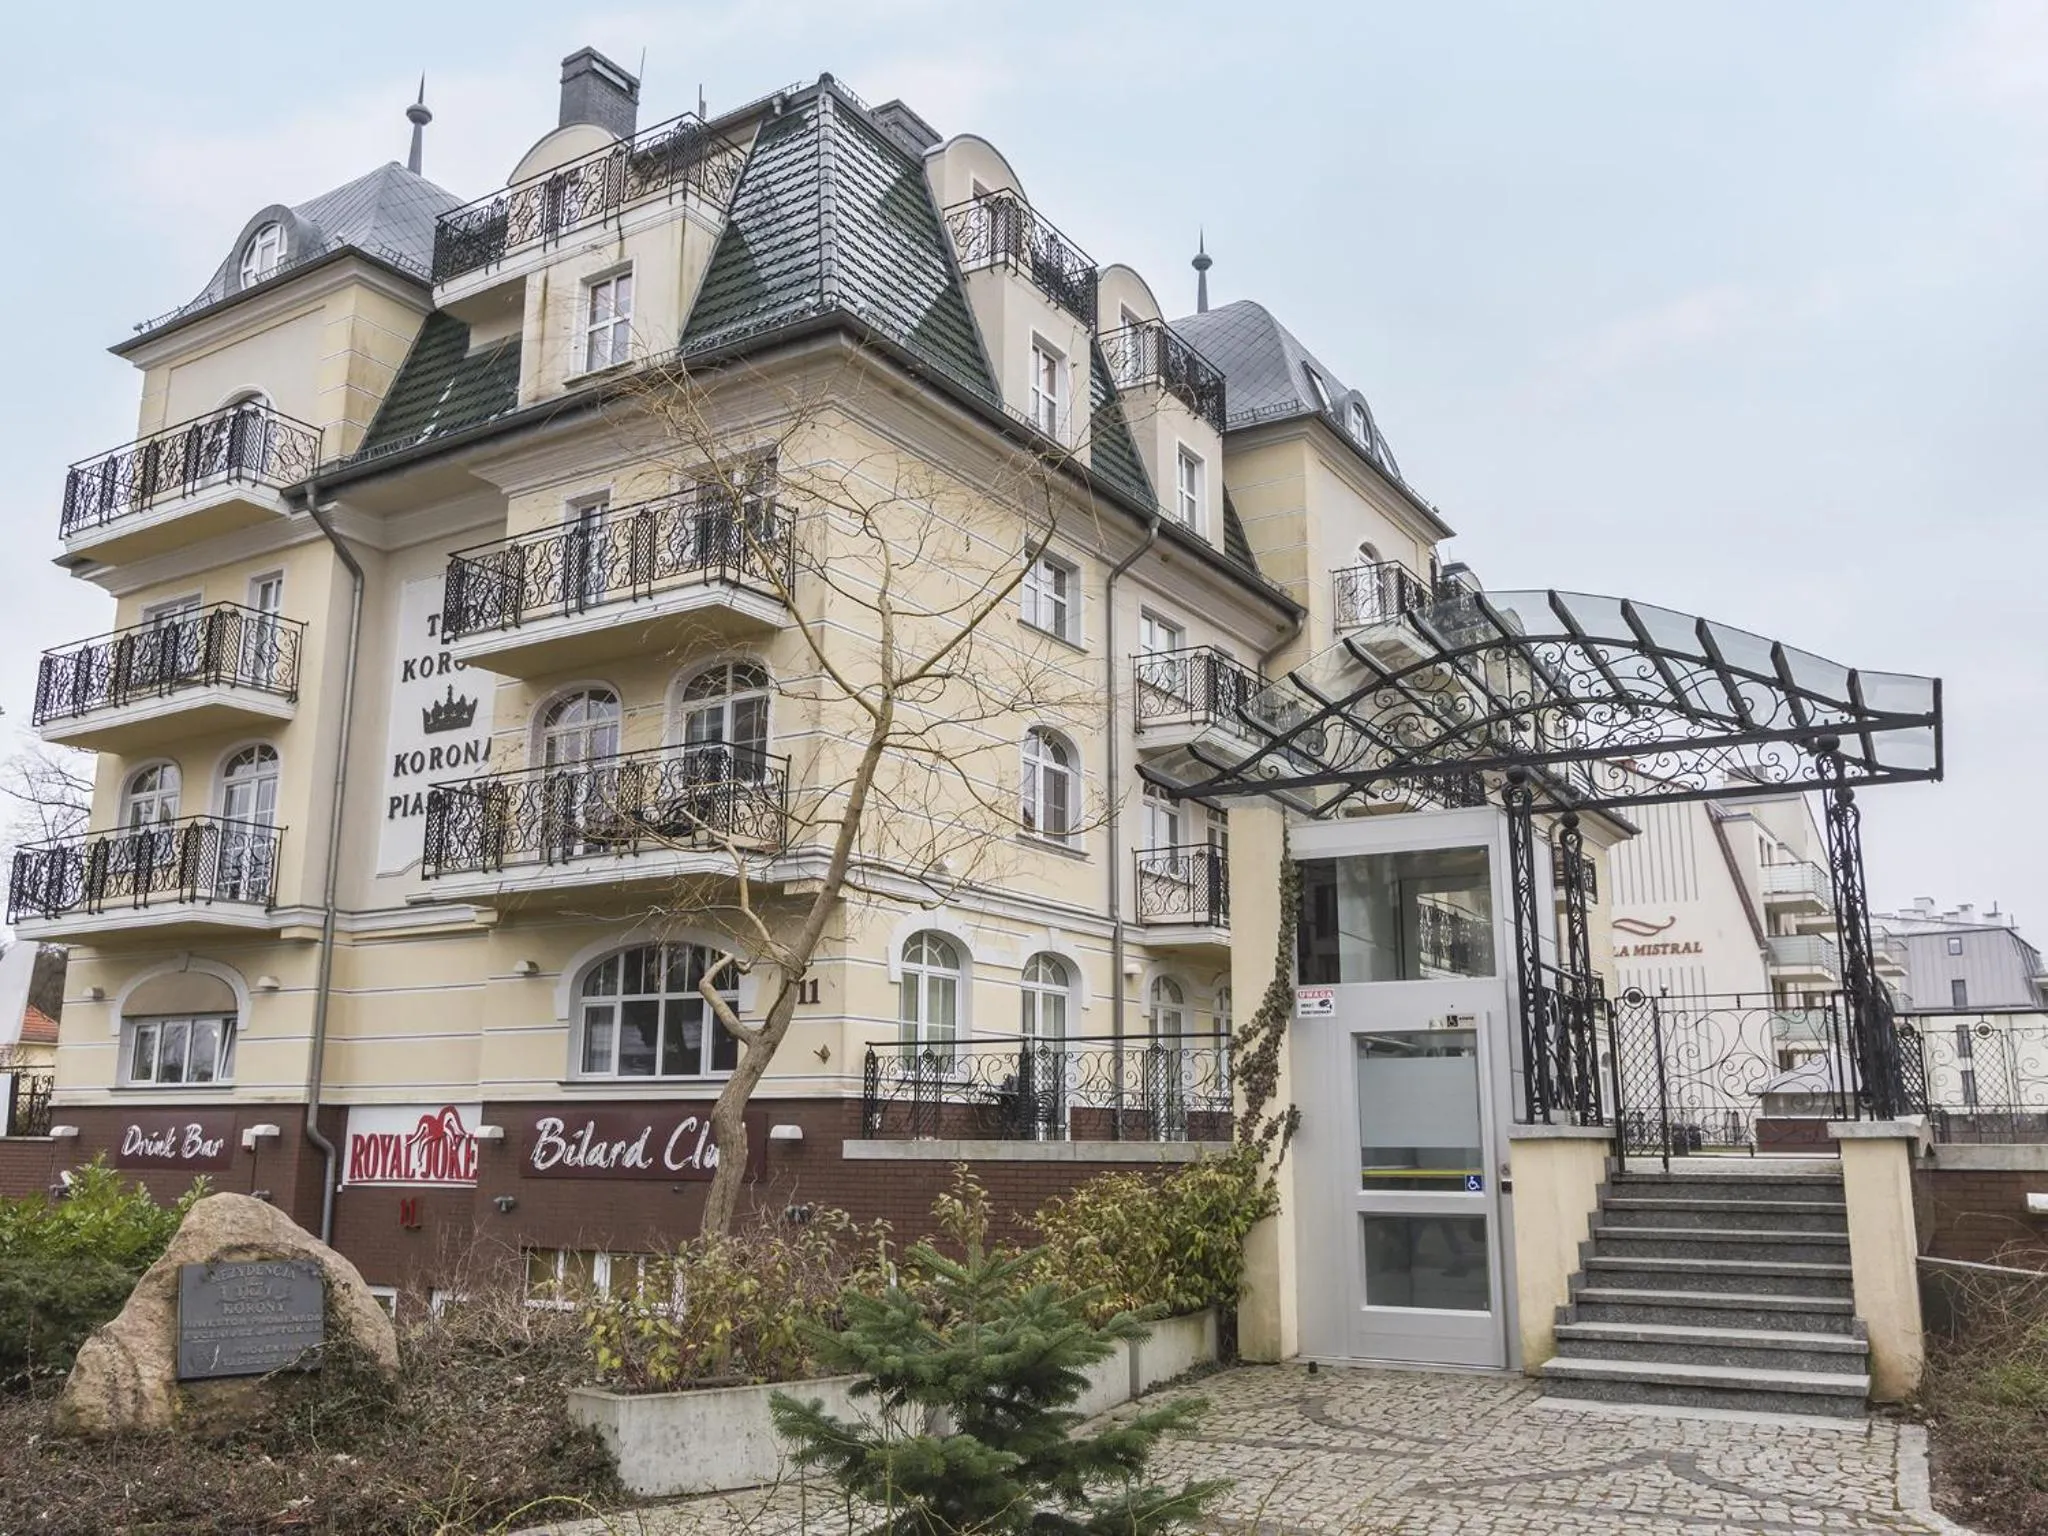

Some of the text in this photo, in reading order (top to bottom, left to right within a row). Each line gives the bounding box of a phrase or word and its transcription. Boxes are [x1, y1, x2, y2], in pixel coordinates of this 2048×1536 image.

[1633, 941, 1703, 956] MISTRAL
[797, 978, 820, 1005] 11
[121, 1123, 224, 1159] Drink Bar
[349, 1133, 479, 1180] ROYAL JOKE
[530, 1116, 742, 1171] Bilard Clu
